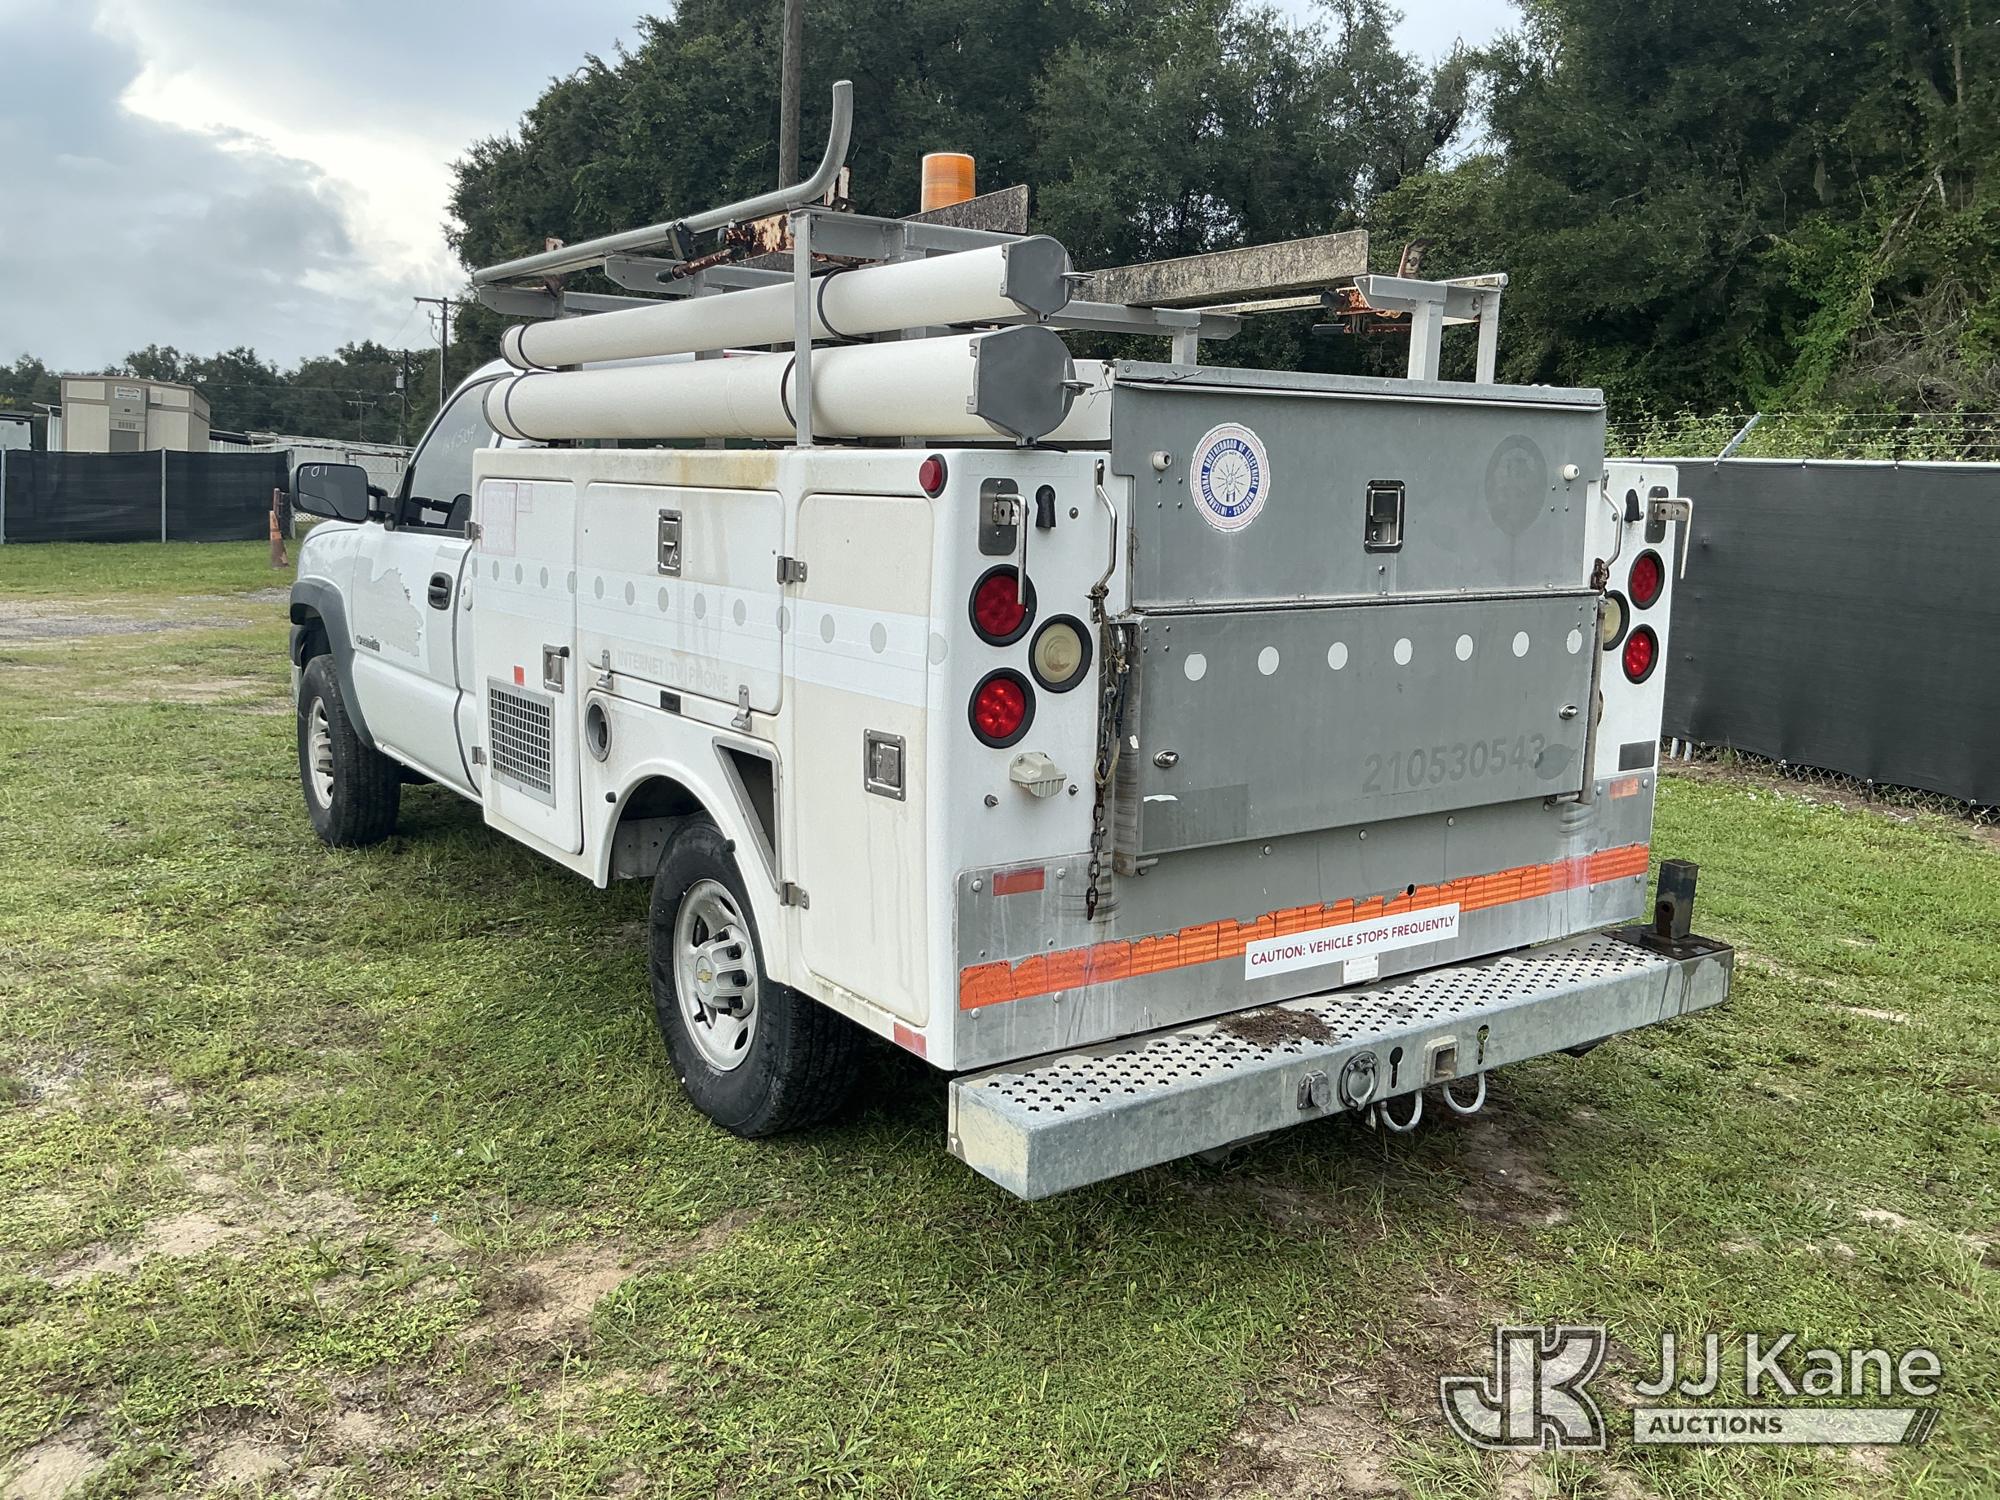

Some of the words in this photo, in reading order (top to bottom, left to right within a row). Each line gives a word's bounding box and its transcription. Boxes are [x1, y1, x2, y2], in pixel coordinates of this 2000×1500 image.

[1251, 944, 1306, 966] CAUTION:
[1309, 935, 1354, 954] VEHICLE
[1356, 929, 1389, 945] STOPS
[1391, 915, 1456, 938] FREQUENTLY
